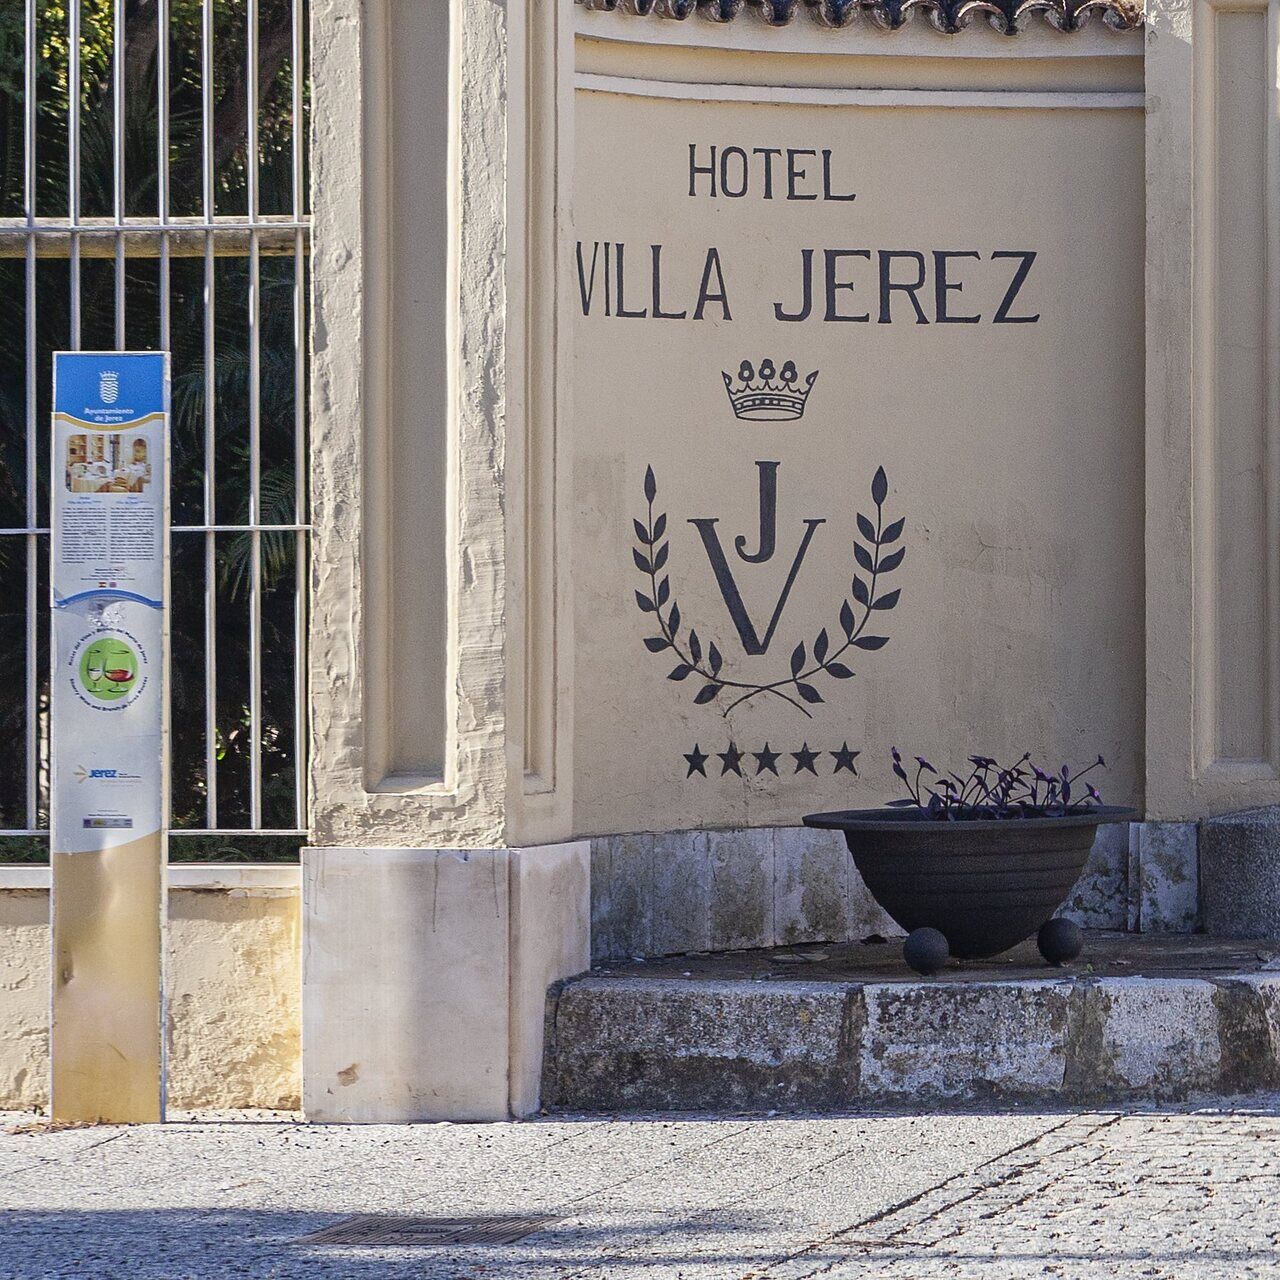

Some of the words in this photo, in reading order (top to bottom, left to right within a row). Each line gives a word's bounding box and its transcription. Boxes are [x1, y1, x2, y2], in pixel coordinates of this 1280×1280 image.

[688, 143, 856, 202] HOTEL
[576, 241, 732, 320] VILLA
[773, 248, 1041, 324] JEREZ
[84, 407, 135, 416] Ayuntamiento
[105, 414, 123, 423] Jerez
